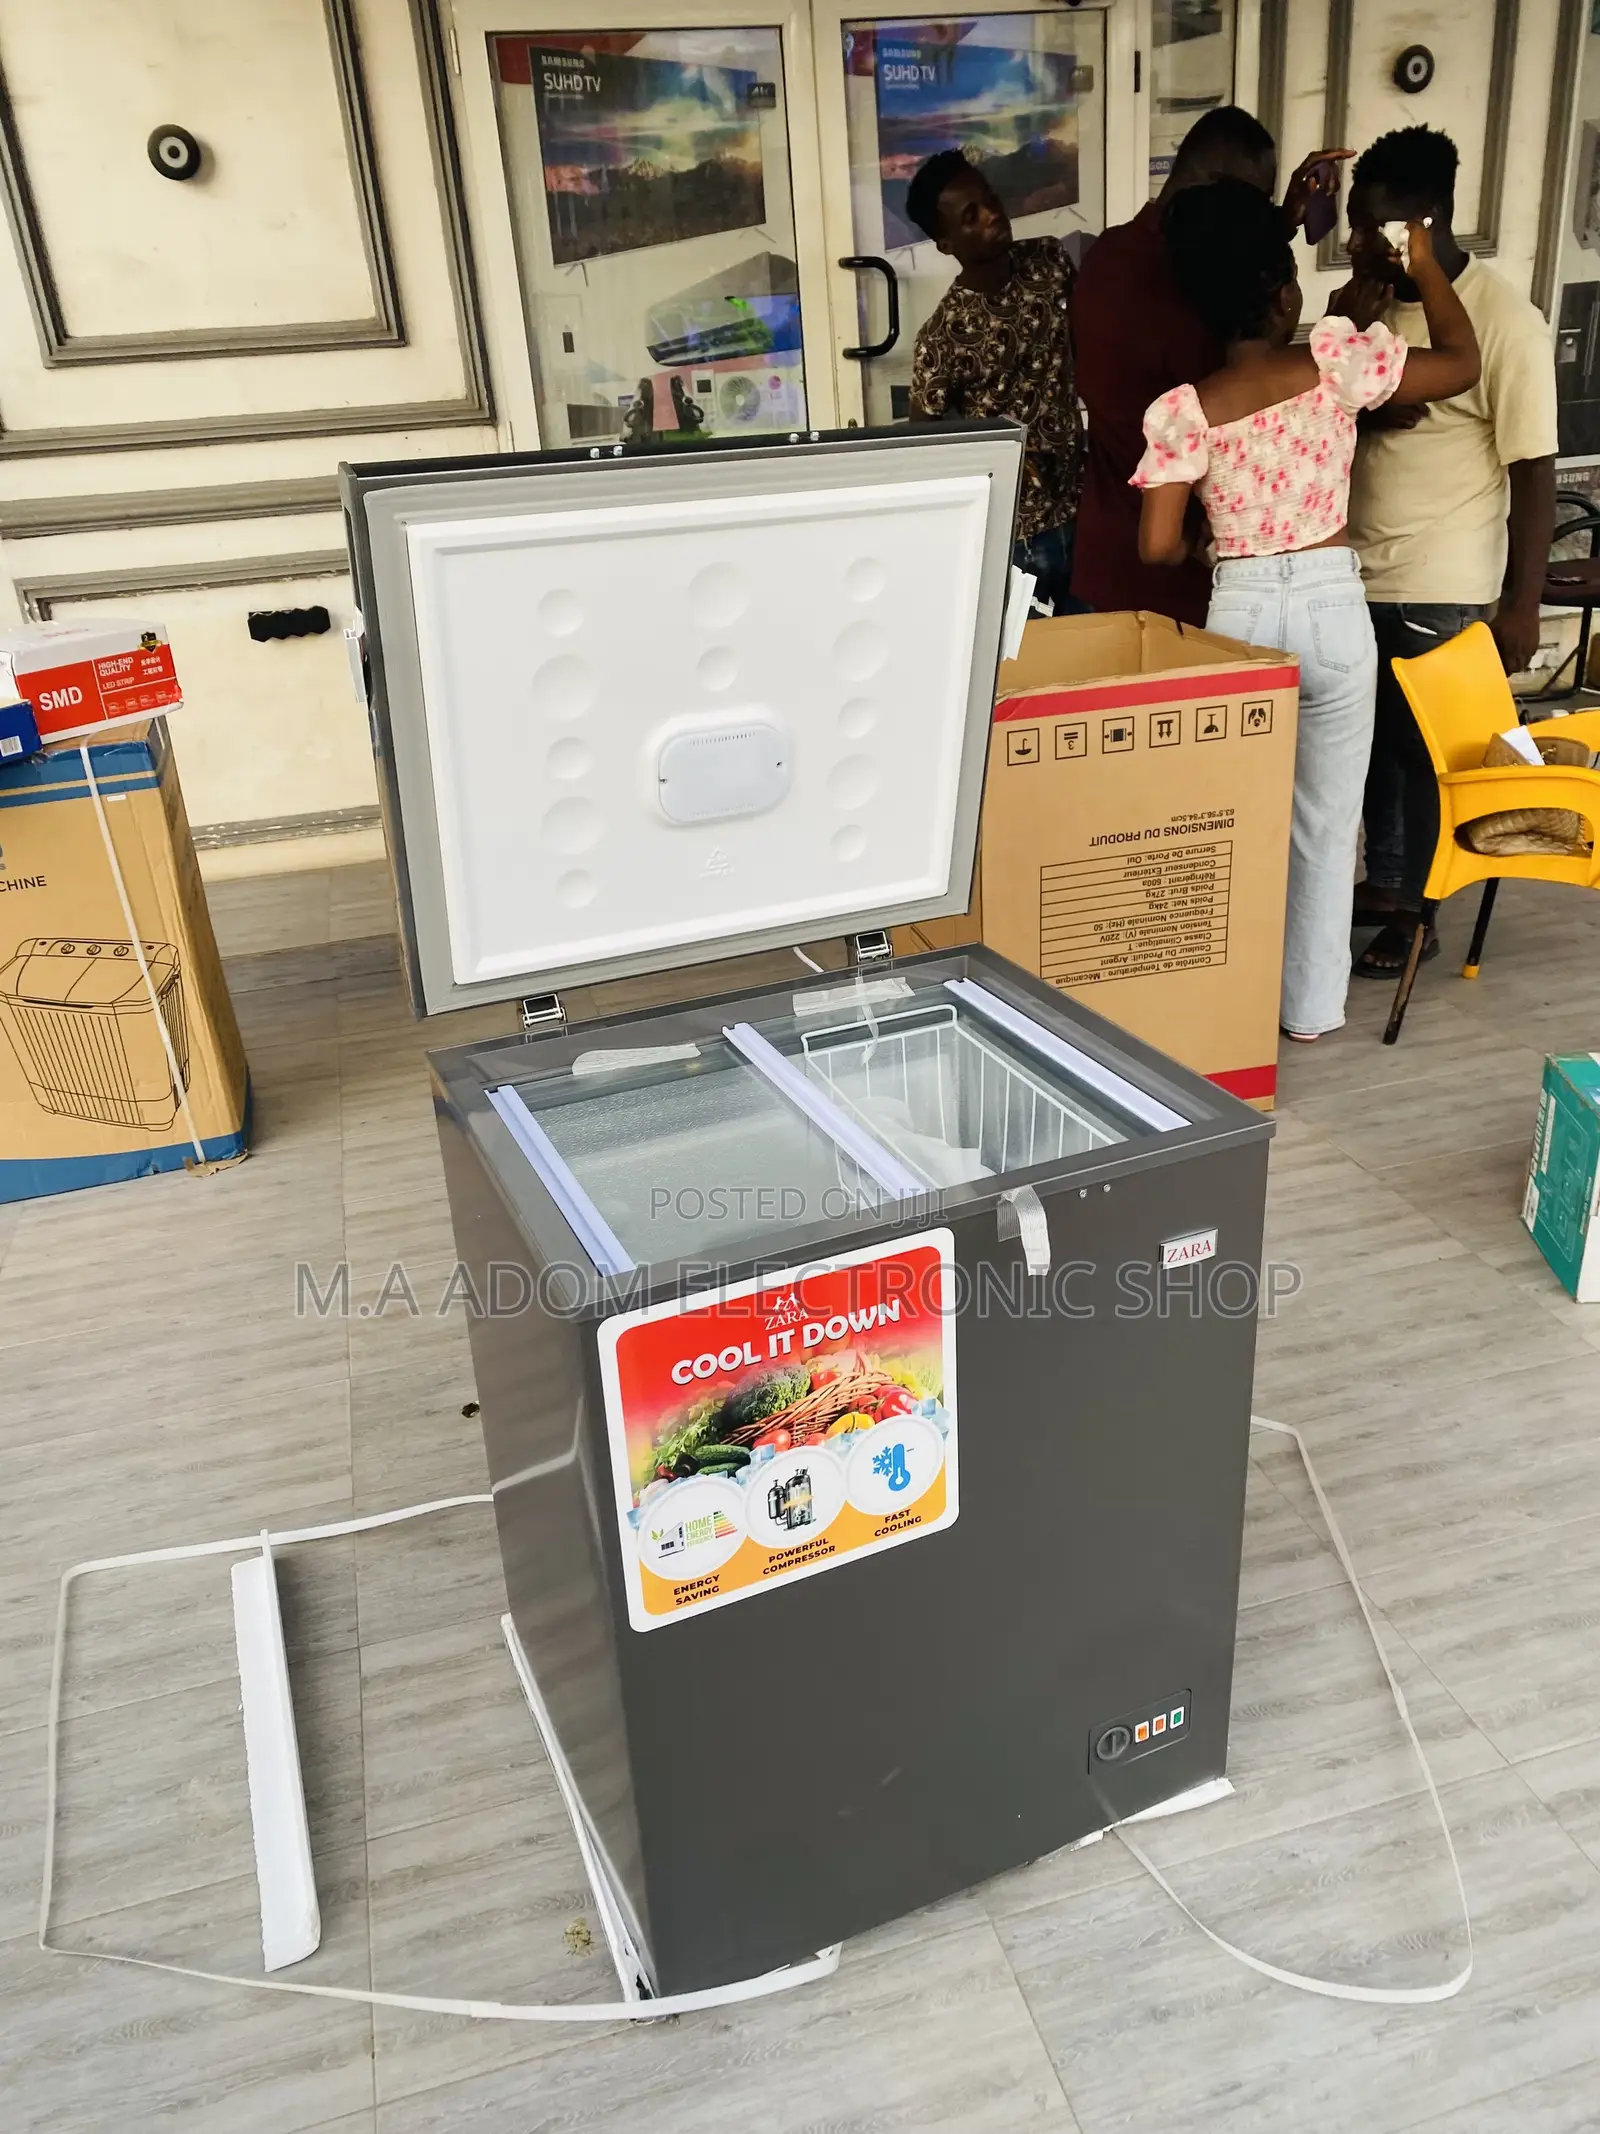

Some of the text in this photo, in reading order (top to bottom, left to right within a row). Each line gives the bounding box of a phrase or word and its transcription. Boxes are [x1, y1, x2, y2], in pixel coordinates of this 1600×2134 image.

[884, 63, 936, 81] SUHD TV
[543, 72, 601, 92] SUHD TV
[98, 656, 134, 670] HIGH-END
[99, 664, 131, 677] QUALITY
[102, 676, 135, 690] LED STRIP
[38, 686, 83, 712] SMD
[1089, 818, 1234, 847] DIMENSIONS DU PRODUIT
[1172, 850, 1183, 858] De
[1186, 845, 1216, 855] Serrure
[1127, 856, 1142, 865] Oui
[1123, 860, 1216, 878] Condenseur Extérieur
[1142, 878, 1162, 887] 600a
[1191, 883, 1214, 892] Poids
[1145, 889, 1165, 898] 27kg
[1149, 901, 1168, 910] 24kg
[1190, 896, 1213, 905] Poids
[1169, 908, 1213, 919] Fréquence
[1128, 915, 1167, 926] Nominale
[1180, 920, 1212, 930] Tension
[1094, 924, 1103, 932] 50
[1139, 925, 1178, 936] Nominale
[1100, 933, 1120, 943] 220V
[1184, 932, 1212, 941] Classe
[1100, 956, 1128, 966] Argent
[1176, 956, 1211, 967] Contrôle
[1167, 1239, 1212, 1263] ZARA
[764, 1307, 810, 1331] ZARA
[671, 1298, 901, 1386] COOL IT DOWN
[884, 1508, 911, 1524] FAST
[685, 1515, 713, 1532] HOME
[874, 1515, 922, 1537] COOLING
[686, 1526, 713, 1541] ENERGY
[768, 1538, 829, 1563] POWERFUL
[762, 1545, 836, 1575] COMPRESSOR
[673, 1574, 721, 1596] ENERGY
[675, 1585, 720, 1606] SAVING
